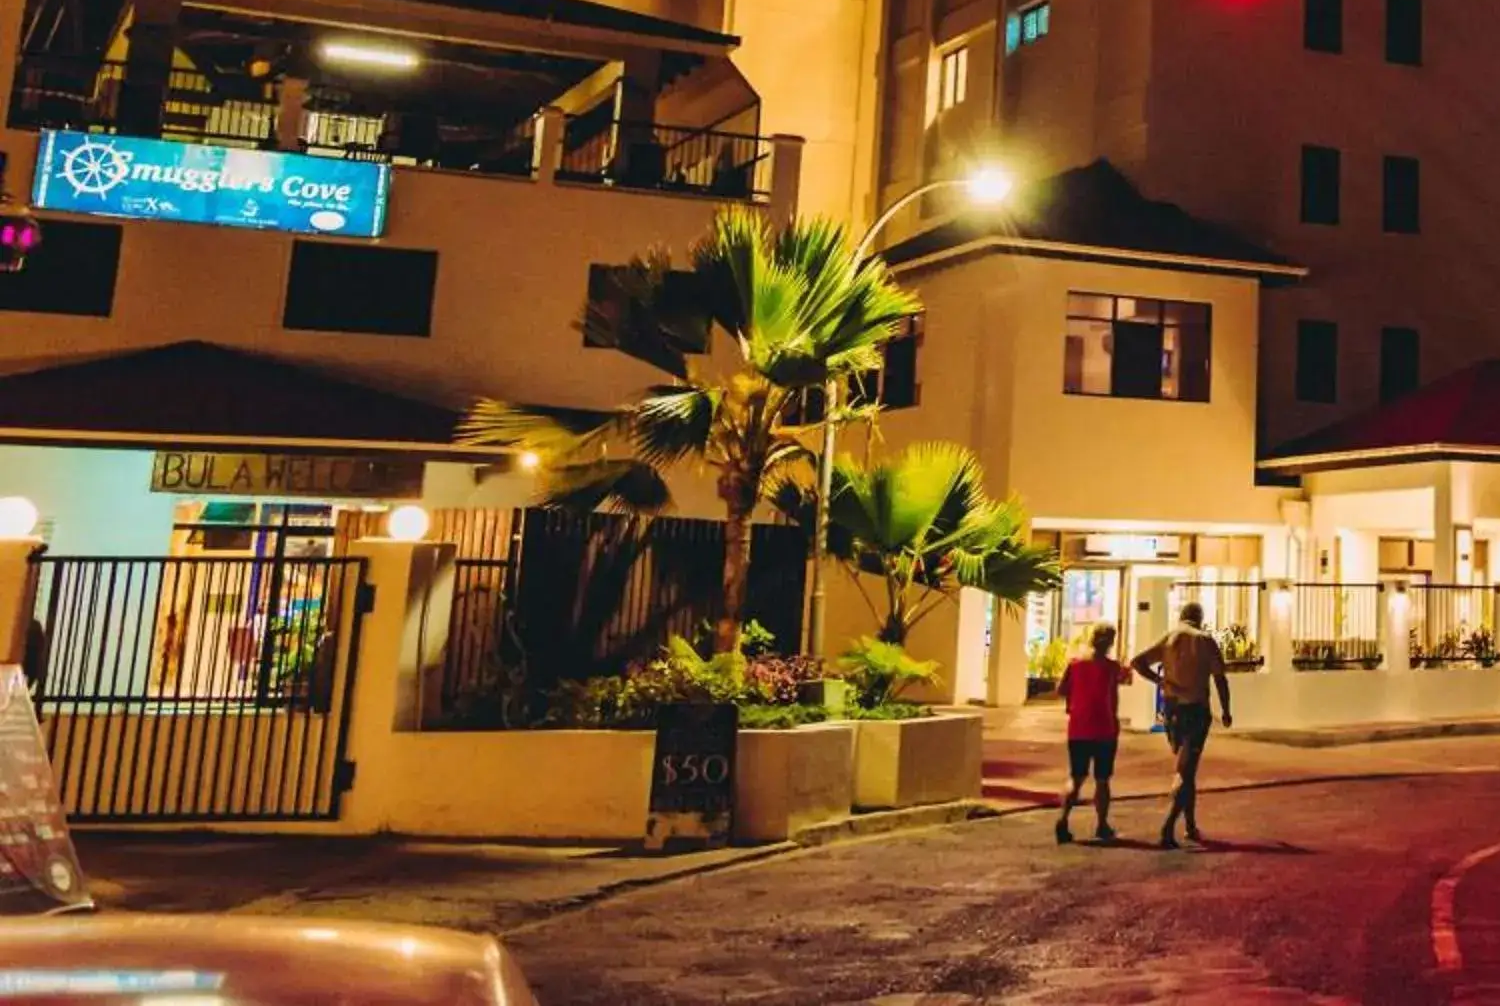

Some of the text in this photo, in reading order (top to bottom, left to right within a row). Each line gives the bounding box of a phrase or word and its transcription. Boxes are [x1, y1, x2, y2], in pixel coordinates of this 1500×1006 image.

[281, 175, 352, 201] Cove
[162, 453, 252, 490] BULA
[660, 753, 729, 786] $50
